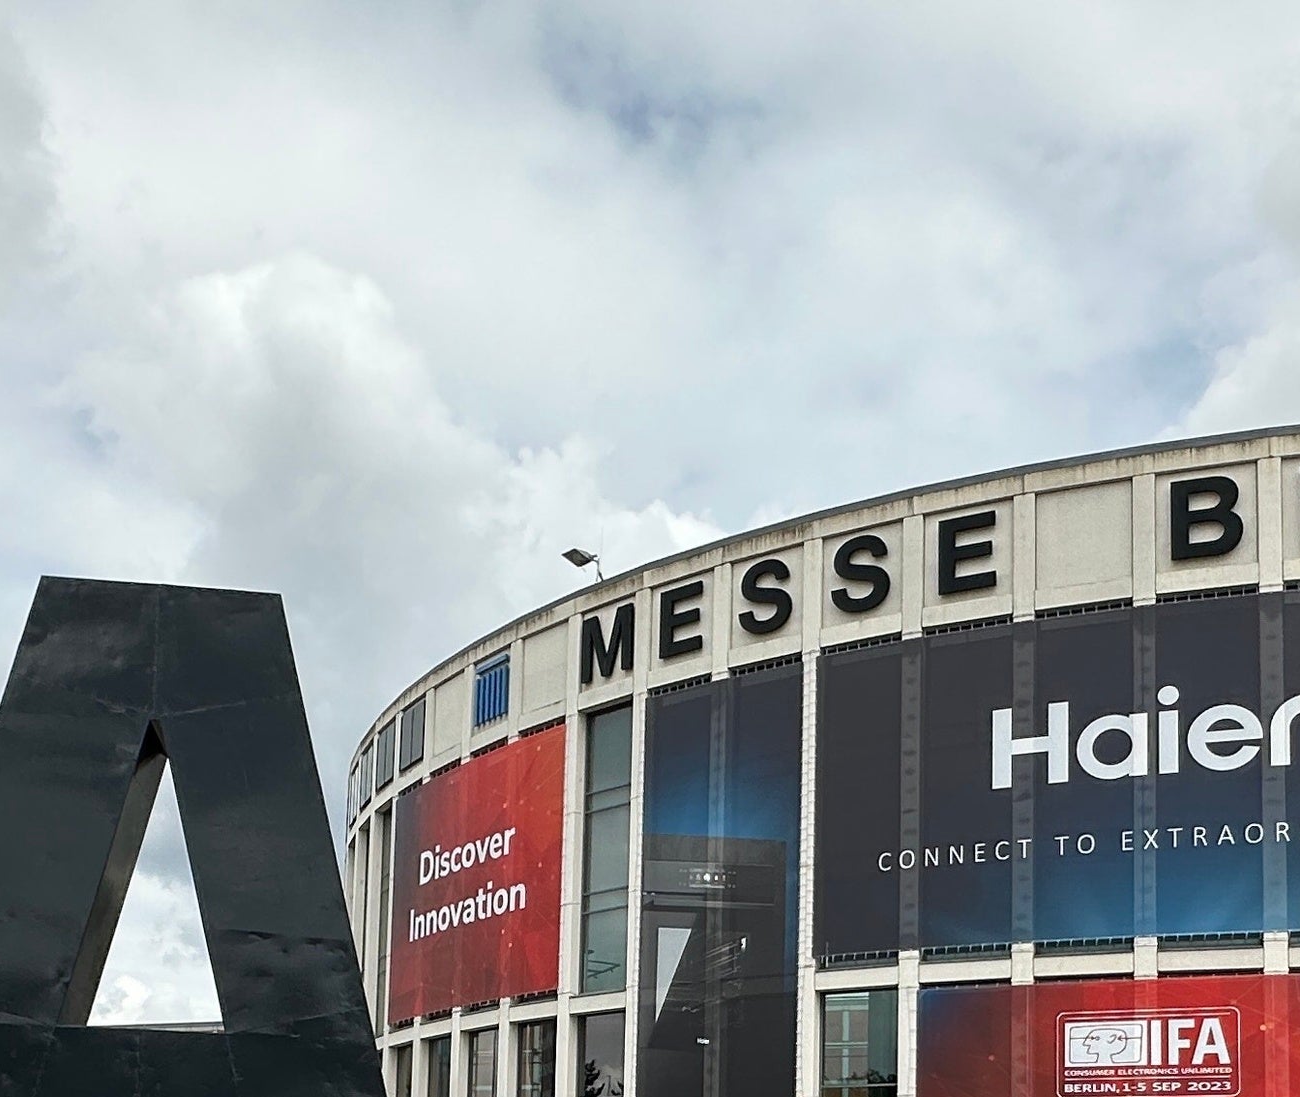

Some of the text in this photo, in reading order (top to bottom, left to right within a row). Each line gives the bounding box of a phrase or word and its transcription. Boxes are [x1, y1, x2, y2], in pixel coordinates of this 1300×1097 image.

[581, 511, 997, 684] MESSE
[419, 825, 517, 886] Discover
[878, 838, 1033, 872] CONNECT
[1055, 834, 1096, 856] TO
[409, 878, 527, 943] Innovation
[1150, 1017, 1232, 1066] IFA
[1064, 1066, 1233, 1077] CONSUMER ELECTRONICS UNLIMITED
[1064, 1081, 1232, 1094] BERLIN, 1-5 SEP 2023
